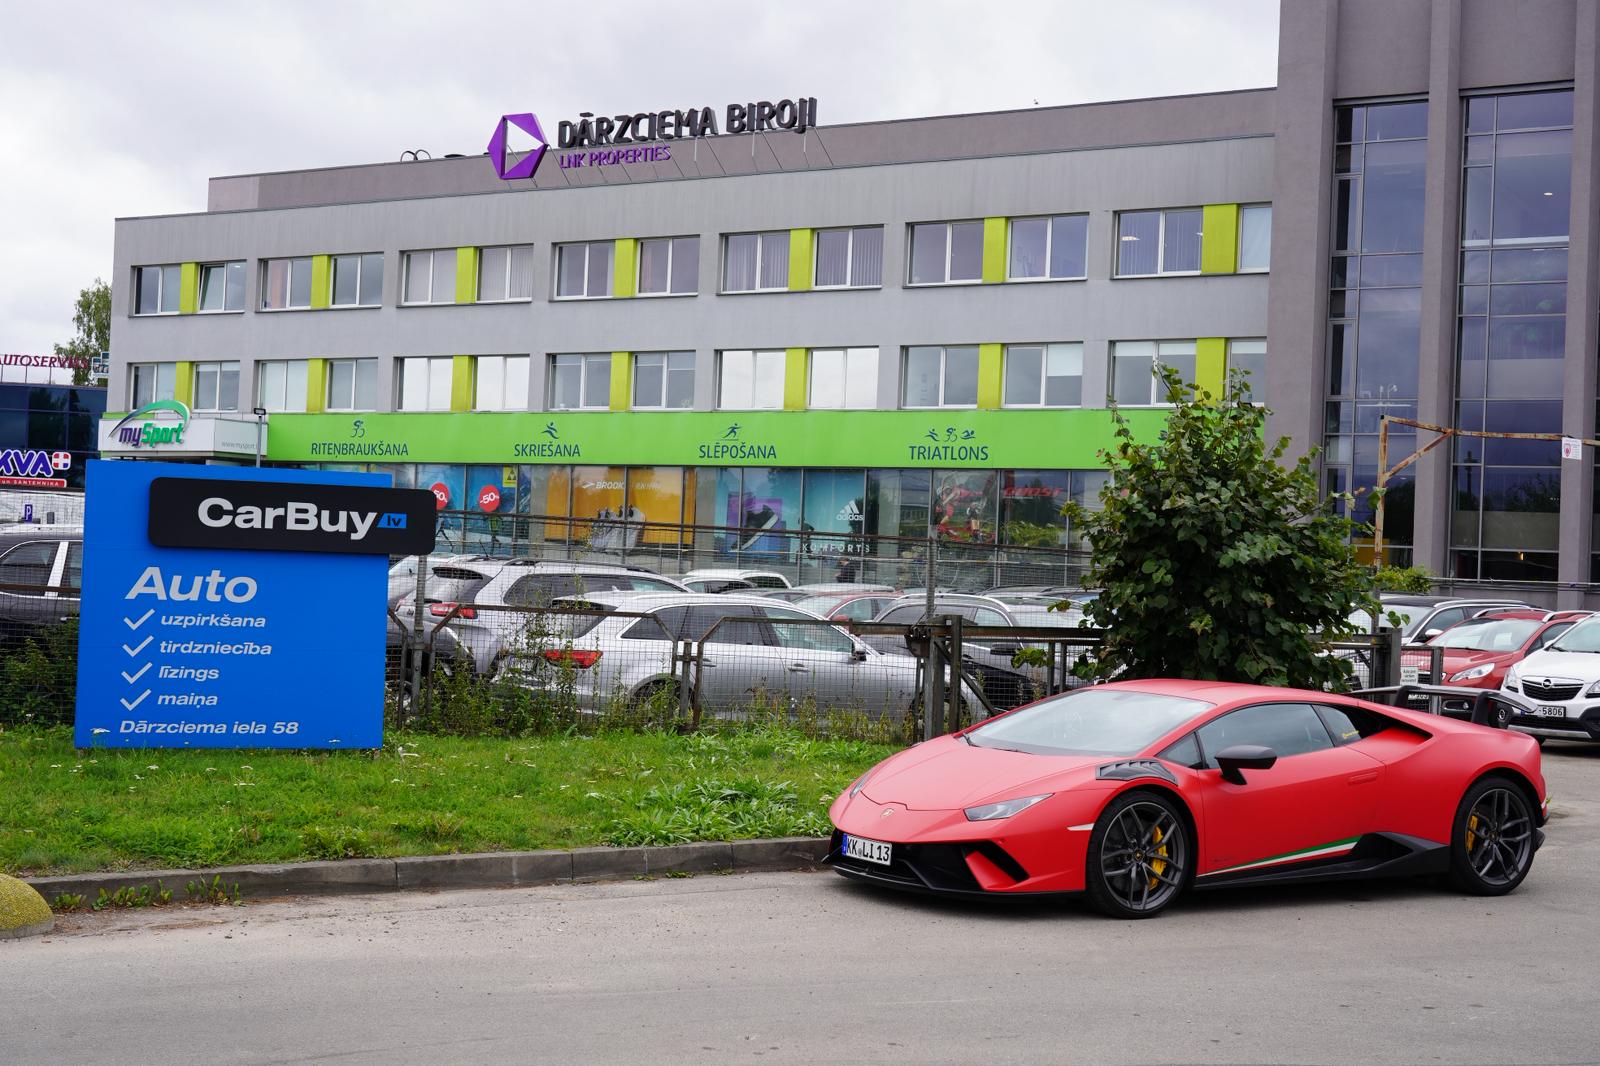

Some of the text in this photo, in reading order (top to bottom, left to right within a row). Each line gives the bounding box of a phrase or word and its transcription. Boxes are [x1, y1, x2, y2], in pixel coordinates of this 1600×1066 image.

[558, 97, 818, 148] DĀRZCIEMA BIROJI
[560, 146, 671, 169] LNK PROPERTIES
[0, 354, 89, 369] UTOSERVISS
[119, 423, 183, 447] mySport
[311, 442, 409, 458] RITEŅBRAUKŠANA
[514, 441, 581, 457] SKRIEŠANA
[698, 442, 777, 460] SLĒPOŠANA
[909, 445, 989, 461] TRIATLONS
[197, 497, 377, 541] CarBuy
[836, 513, 863, 521] adidas
[124, 566, 258, 603] Auto
[161, 613, 266, 628] uzpirkšana
[159, 641, 272, 655] tirdzniecība
[158, 665, 220, 681] līzings
[157, 692, 218, 708] maiņa
[119, 720, 299, 734] Dārzciema iela 58
